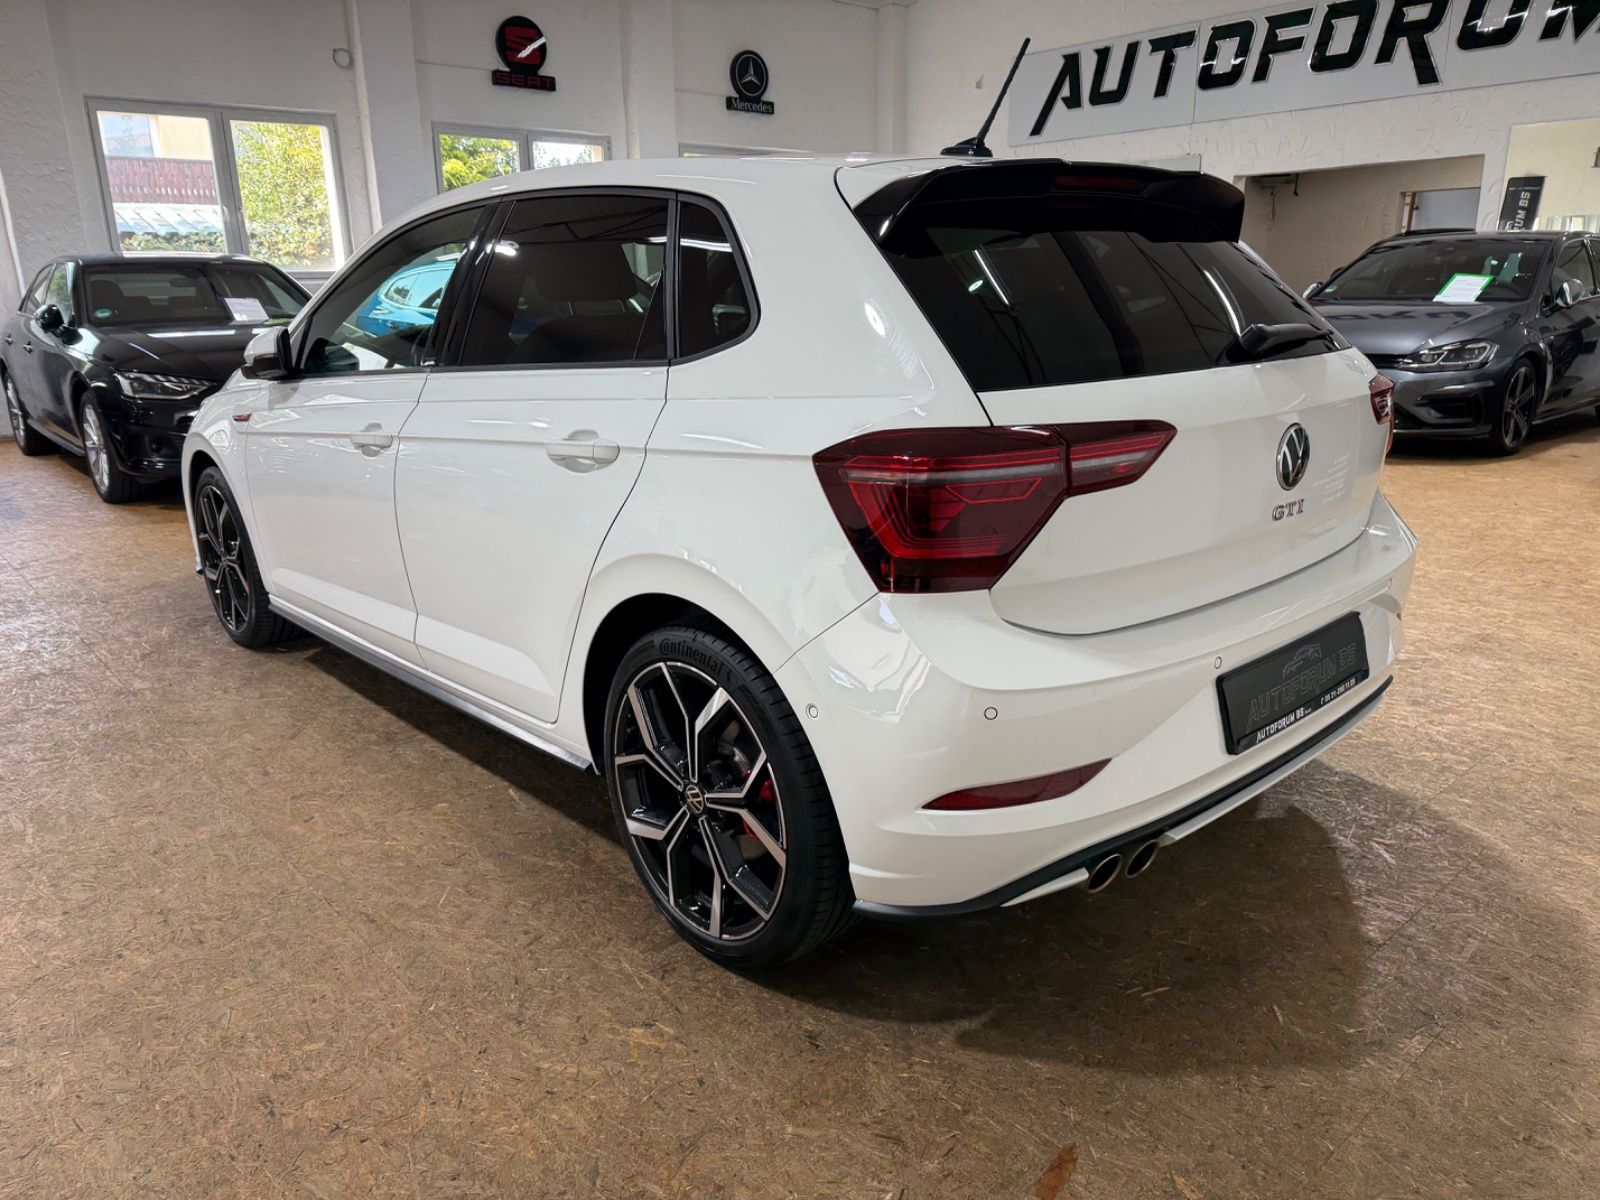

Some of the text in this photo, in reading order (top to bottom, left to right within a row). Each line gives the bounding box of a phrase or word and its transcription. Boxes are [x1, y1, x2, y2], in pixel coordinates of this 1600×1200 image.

[495, 71, 553, 88] SEAT
[731, 99, 773, 113] Mercedes
[1272, 499, 1305, 521] GTI
[659, 638, 724, 677] Continental
[1256, 712, 1295, 743] AUTOFORUM
